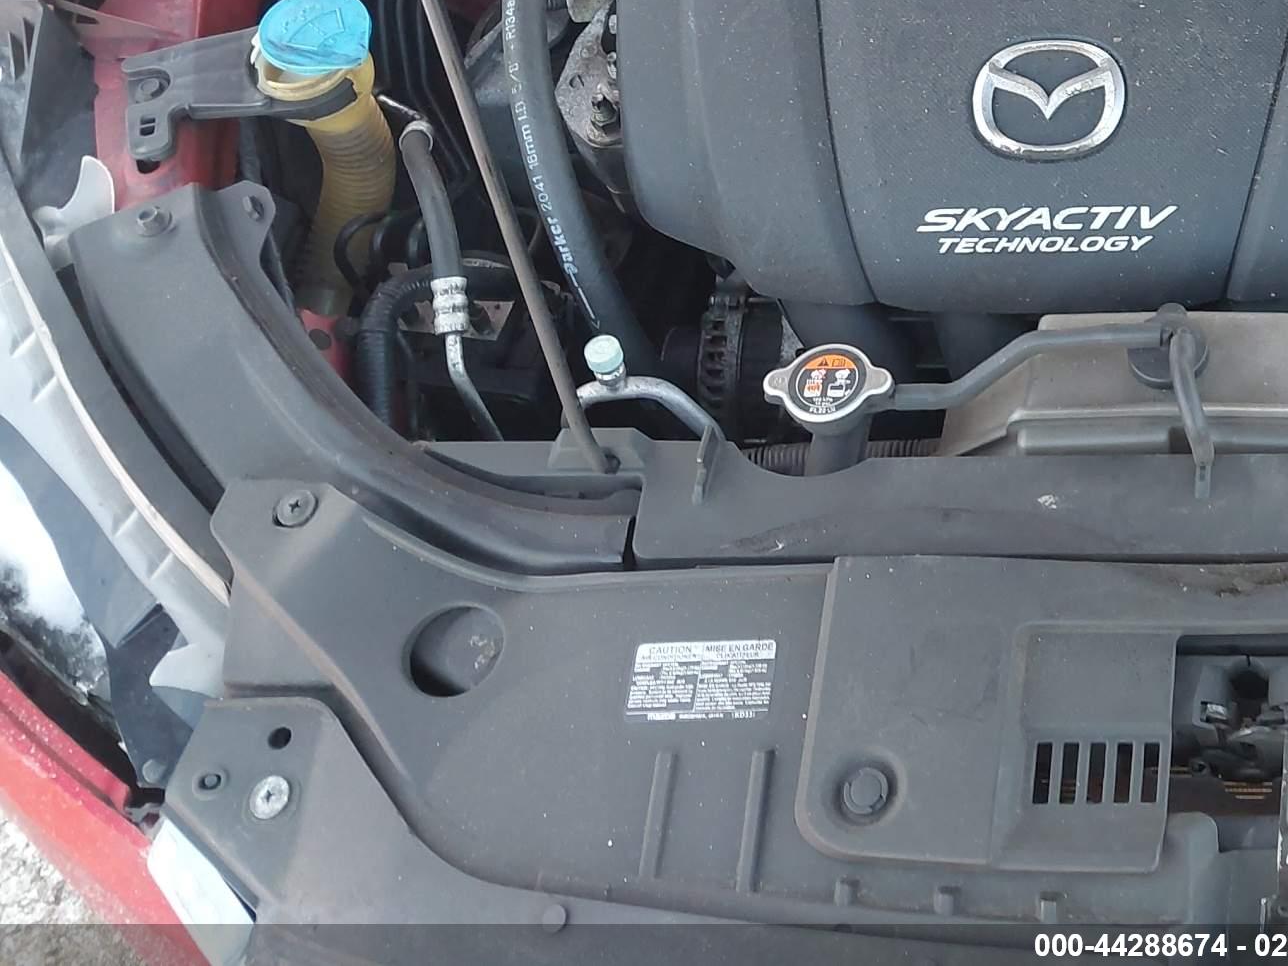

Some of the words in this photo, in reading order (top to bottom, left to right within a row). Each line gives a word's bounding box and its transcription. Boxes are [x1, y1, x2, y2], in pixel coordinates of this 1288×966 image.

[505, 0, 517, 41] R134a
[521, 124, 539, 170] 16mm
[532, 175, 553, 212] 2041
[916, 206, 1178, 232] SKYACTIV
[938, 235, 1153, 254] TECHNOLOGY
[649, 646, 693, 654] CAUTION
[705, 643, 727, 652] MISE
[728, 643, 742, 651] EN
[743, 642, 774, 651] GARDE
